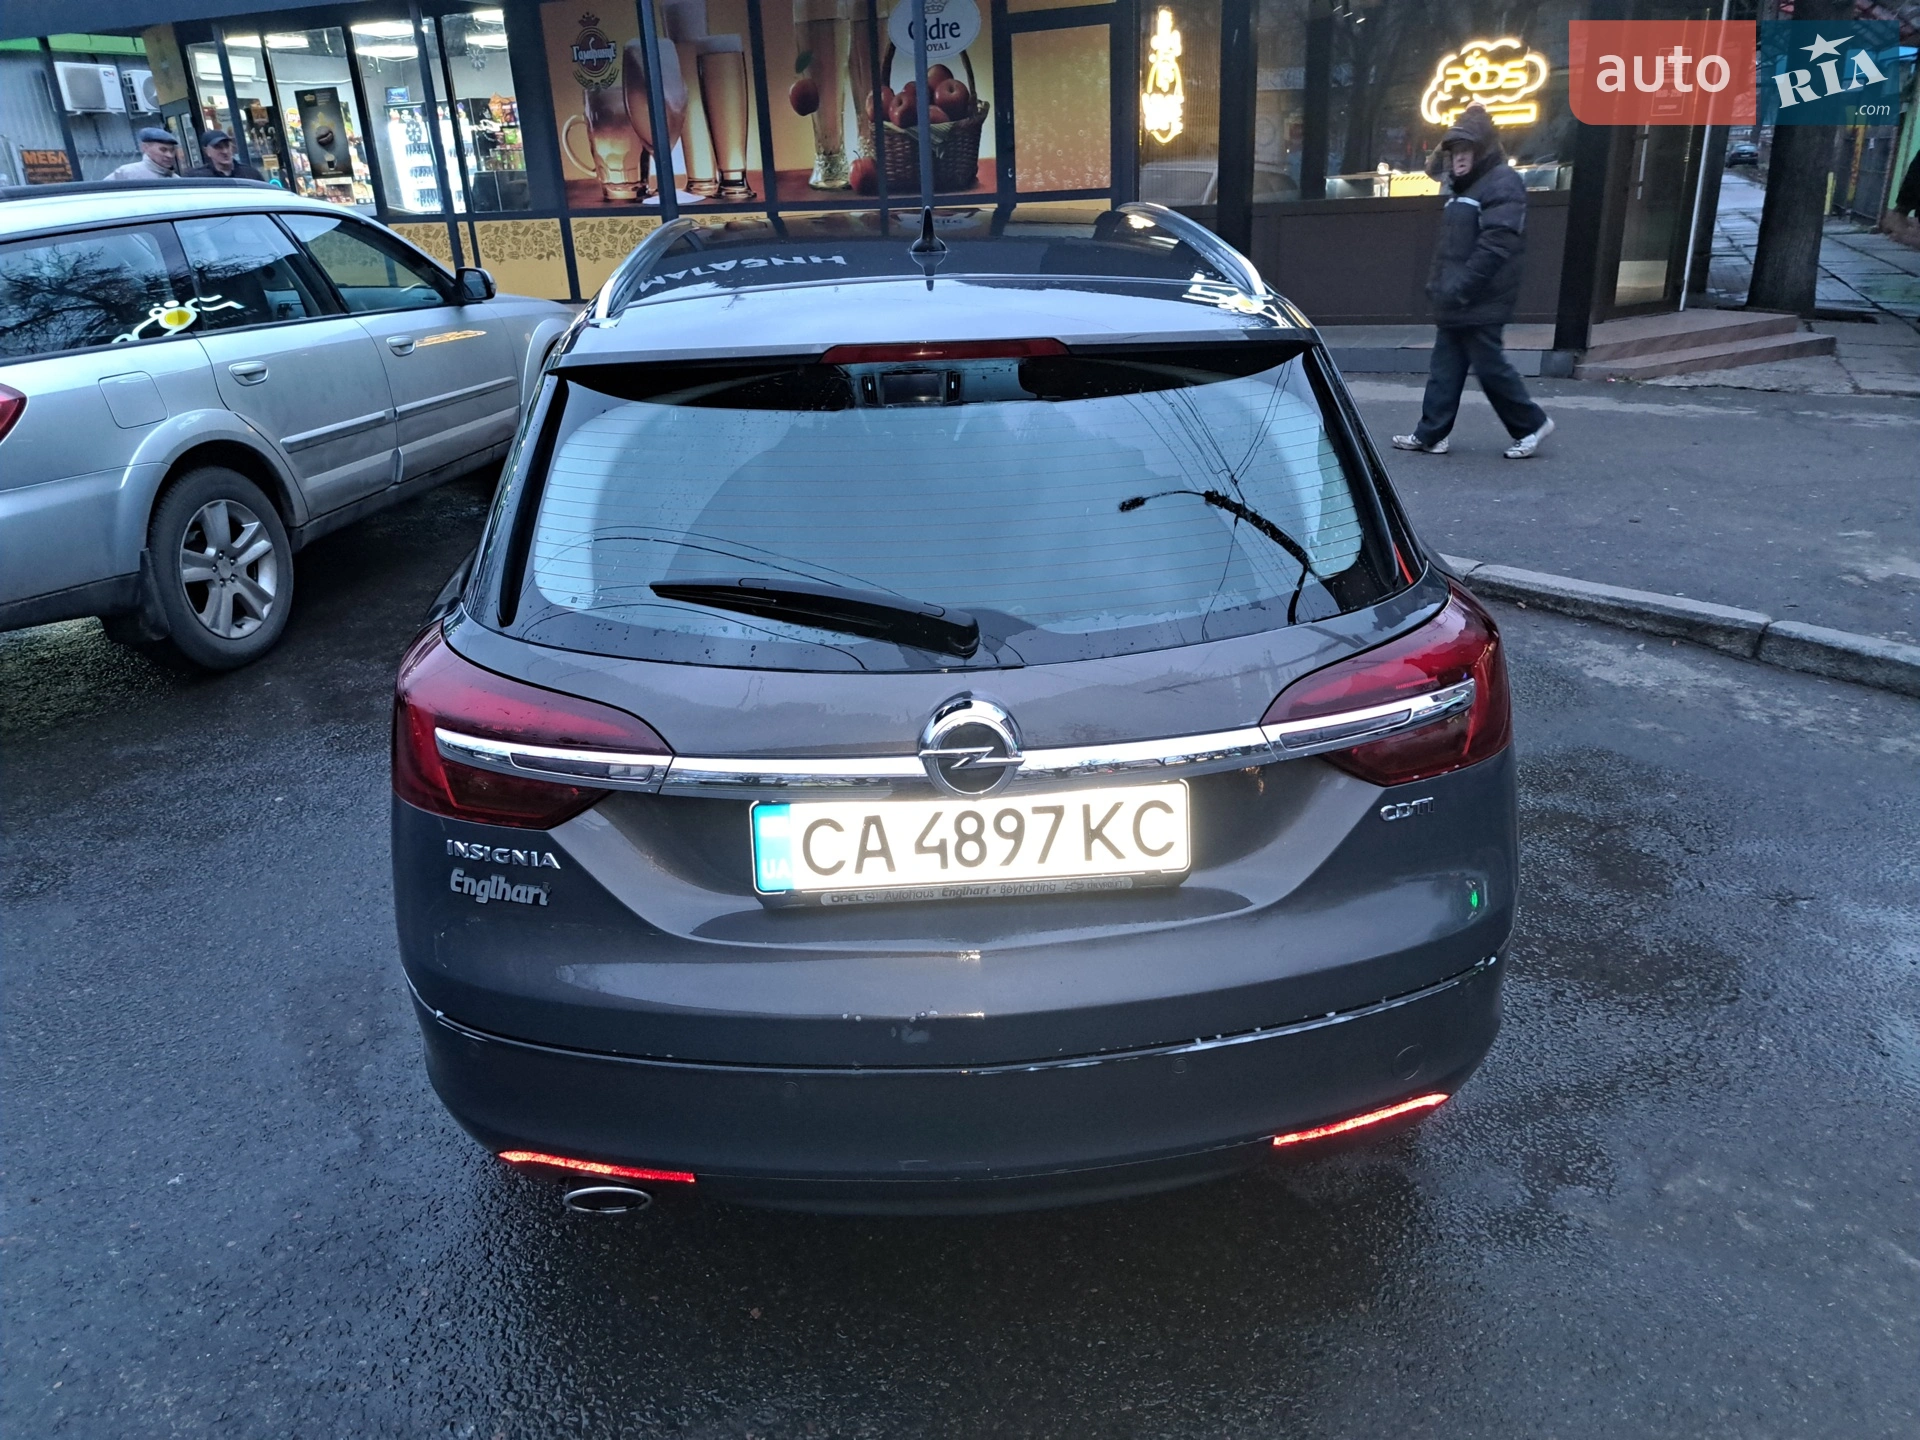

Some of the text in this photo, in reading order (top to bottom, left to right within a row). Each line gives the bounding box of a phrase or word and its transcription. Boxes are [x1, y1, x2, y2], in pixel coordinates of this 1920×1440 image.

[926, 42, 951, 52] OYAL
[22, 151, 68, 165] МЕБЛ
[802, 800, 1175, 876] CA 4897 KC
[446, 839, 561, 870] INSIGNIA
[450, 867, 550, 906] Englhart
[831, 893, 863, 903] OPEL
[884, 889, 934, 900] Autohaus
[942, 885, 990, 899] Englhart
